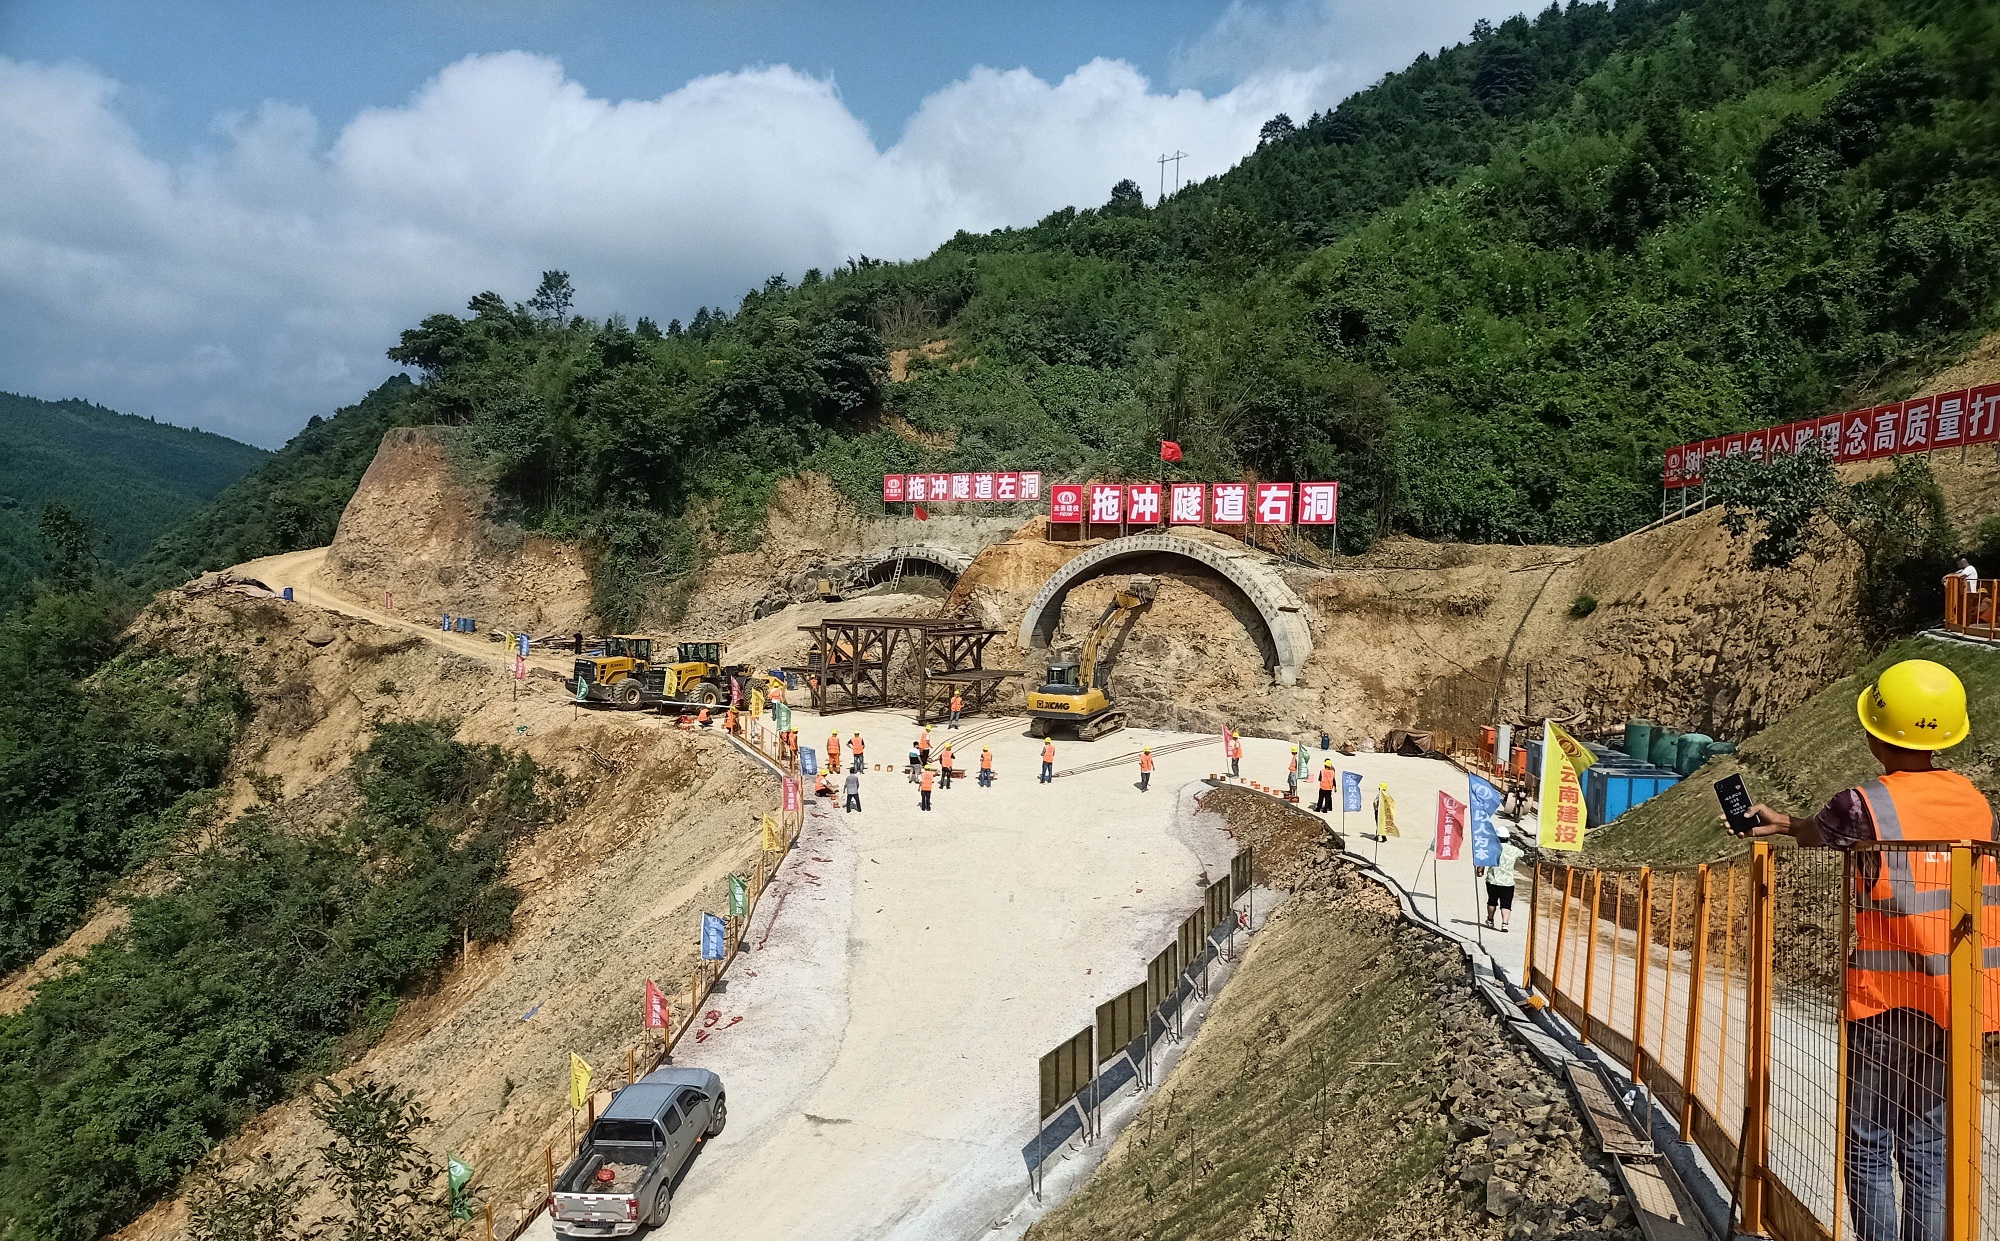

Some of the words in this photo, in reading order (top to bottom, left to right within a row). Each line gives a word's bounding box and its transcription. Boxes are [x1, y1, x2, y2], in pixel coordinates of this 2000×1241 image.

[908, 474, 1039, 500] 拖冲隧道左洞
[1092, 485, 1334, 522] 拖冲隧道右洞
[1044, 701, 1070, 710] XCMG
[1914, 717, 1938, 730] 44
[1554, 765, 1579, 845] 云南建投
[1473, 809, 1492, 861] 以人为本
